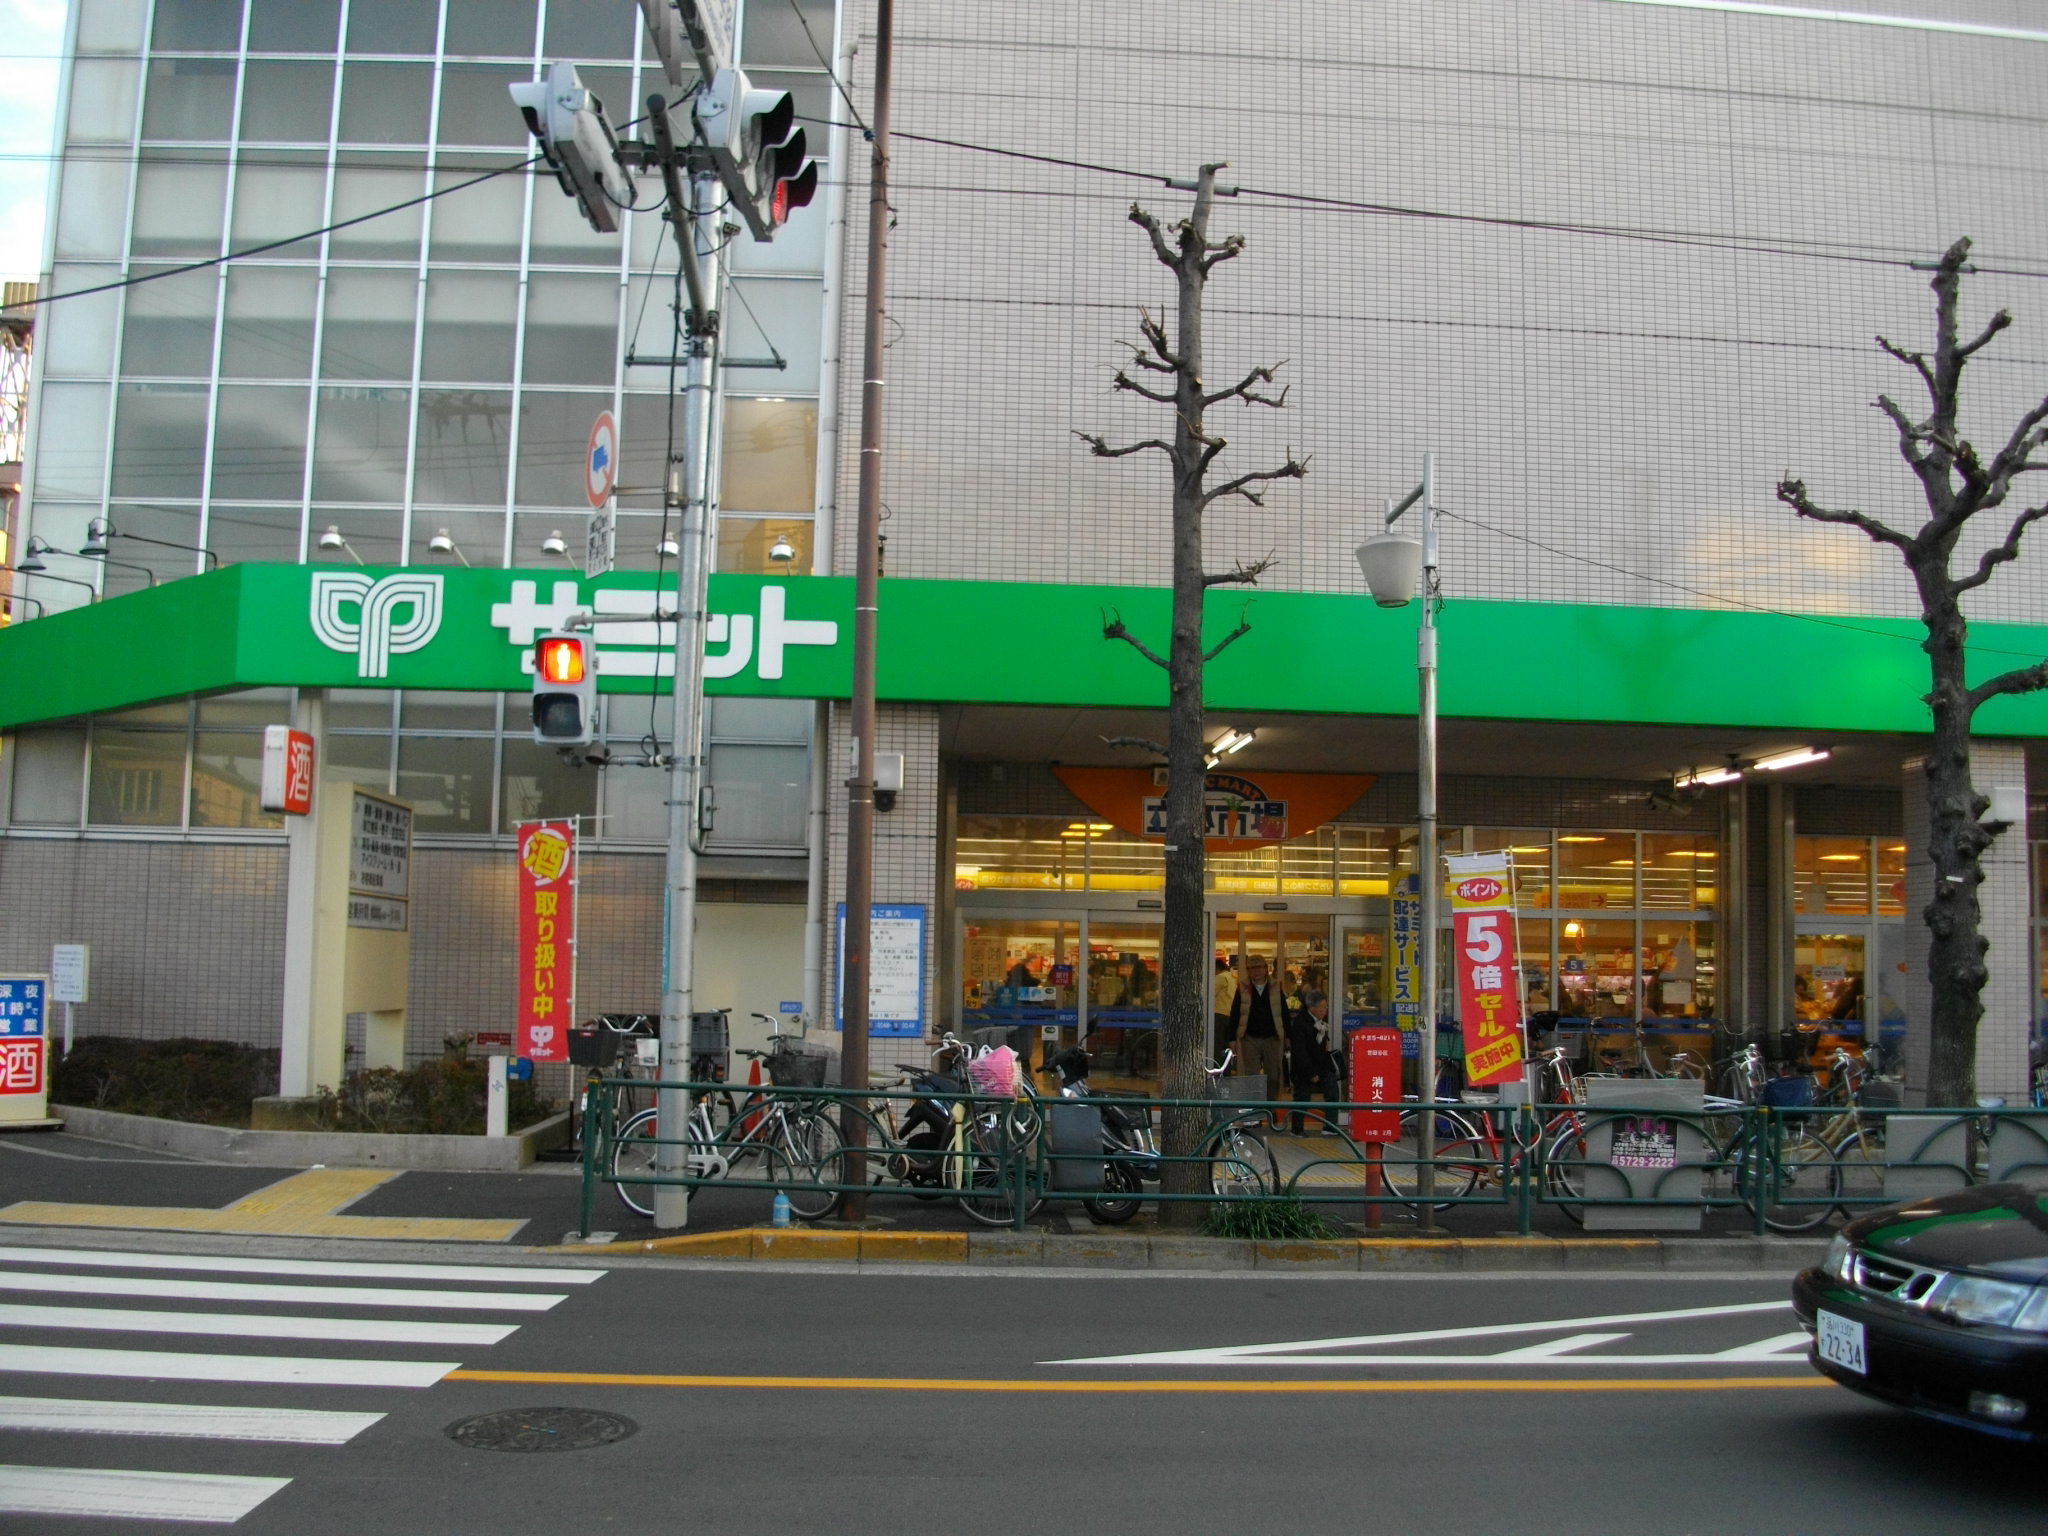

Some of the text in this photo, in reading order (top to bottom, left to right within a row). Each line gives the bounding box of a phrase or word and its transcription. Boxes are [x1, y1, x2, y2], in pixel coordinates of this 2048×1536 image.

[491, 579, 838, 680] サミット
[289, 741, 311, 801] 酒
[524, 831, 568, 881] 酒
[1460, 883, 1499, 897] ポイント
[533, 891, 558, 1019] 取り扱い中
[0, 1043, 39, 1088] 酒
[1470, 1041, 1515, 1074] 実施中
[1620, 1156, 1673, 1167] 5729-2222
